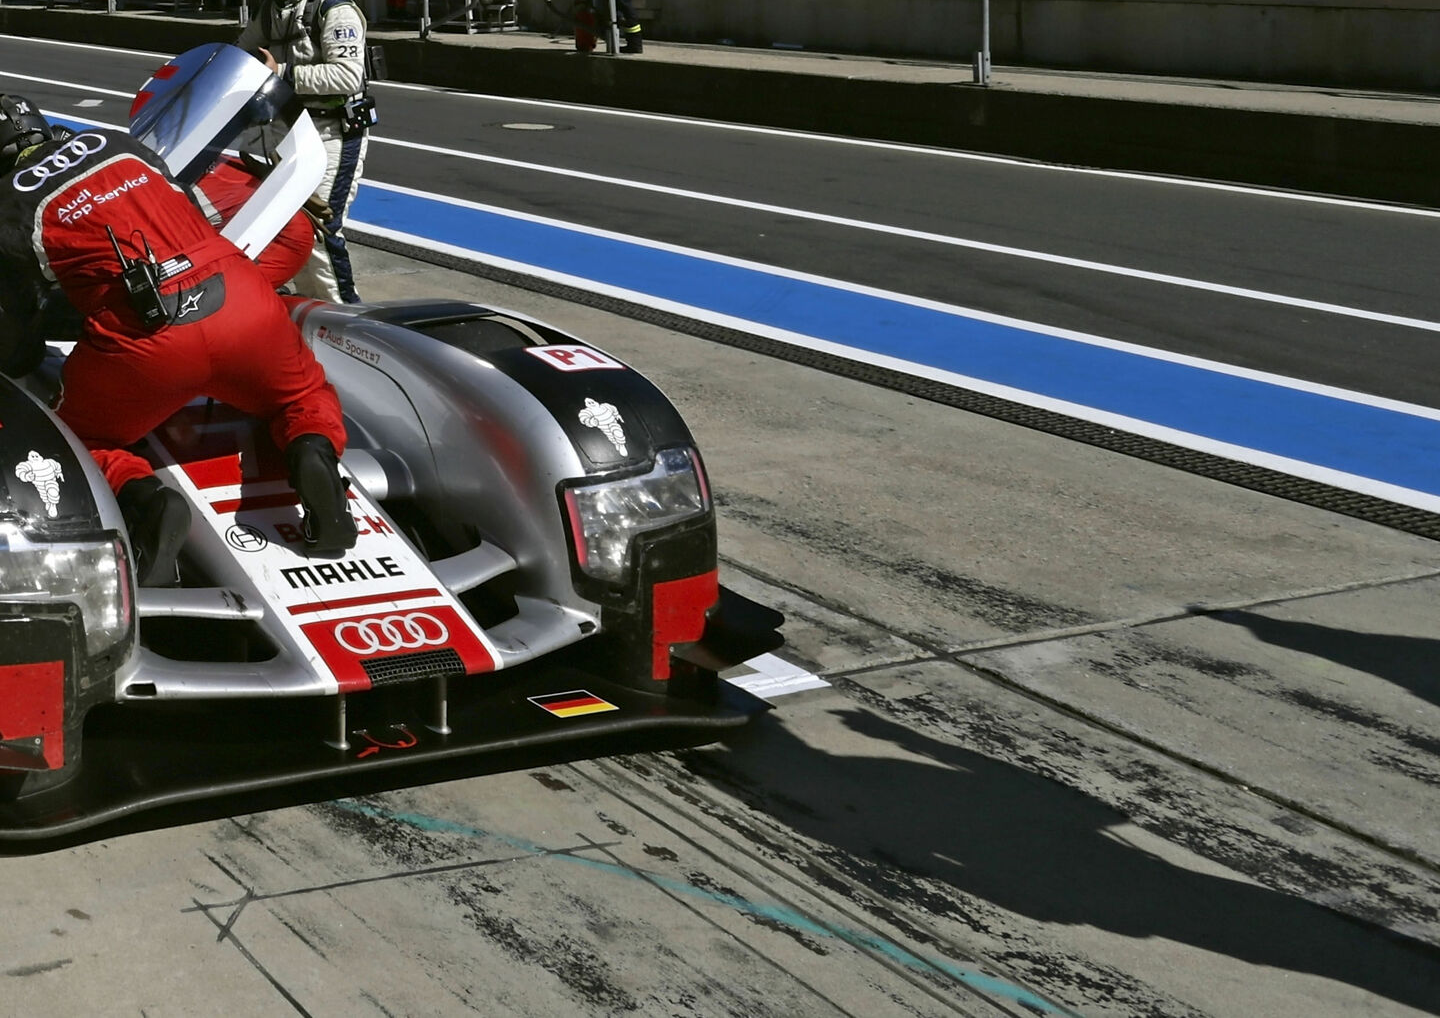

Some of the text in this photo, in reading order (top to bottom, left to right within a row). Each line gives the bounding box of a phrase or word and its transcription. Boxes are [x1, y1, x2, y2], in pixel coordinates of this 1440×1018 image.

[334, 28, 357, 40] FIA
[337, 45, 358, 58] 28
[57, 188, 92, 220] Audi
[61, 175, 149, 225] Top Service
[325, 329, 344, 346] Audi
[543, 348, 607, 366] P1
[280, 556, 405, 589] MAHLE
